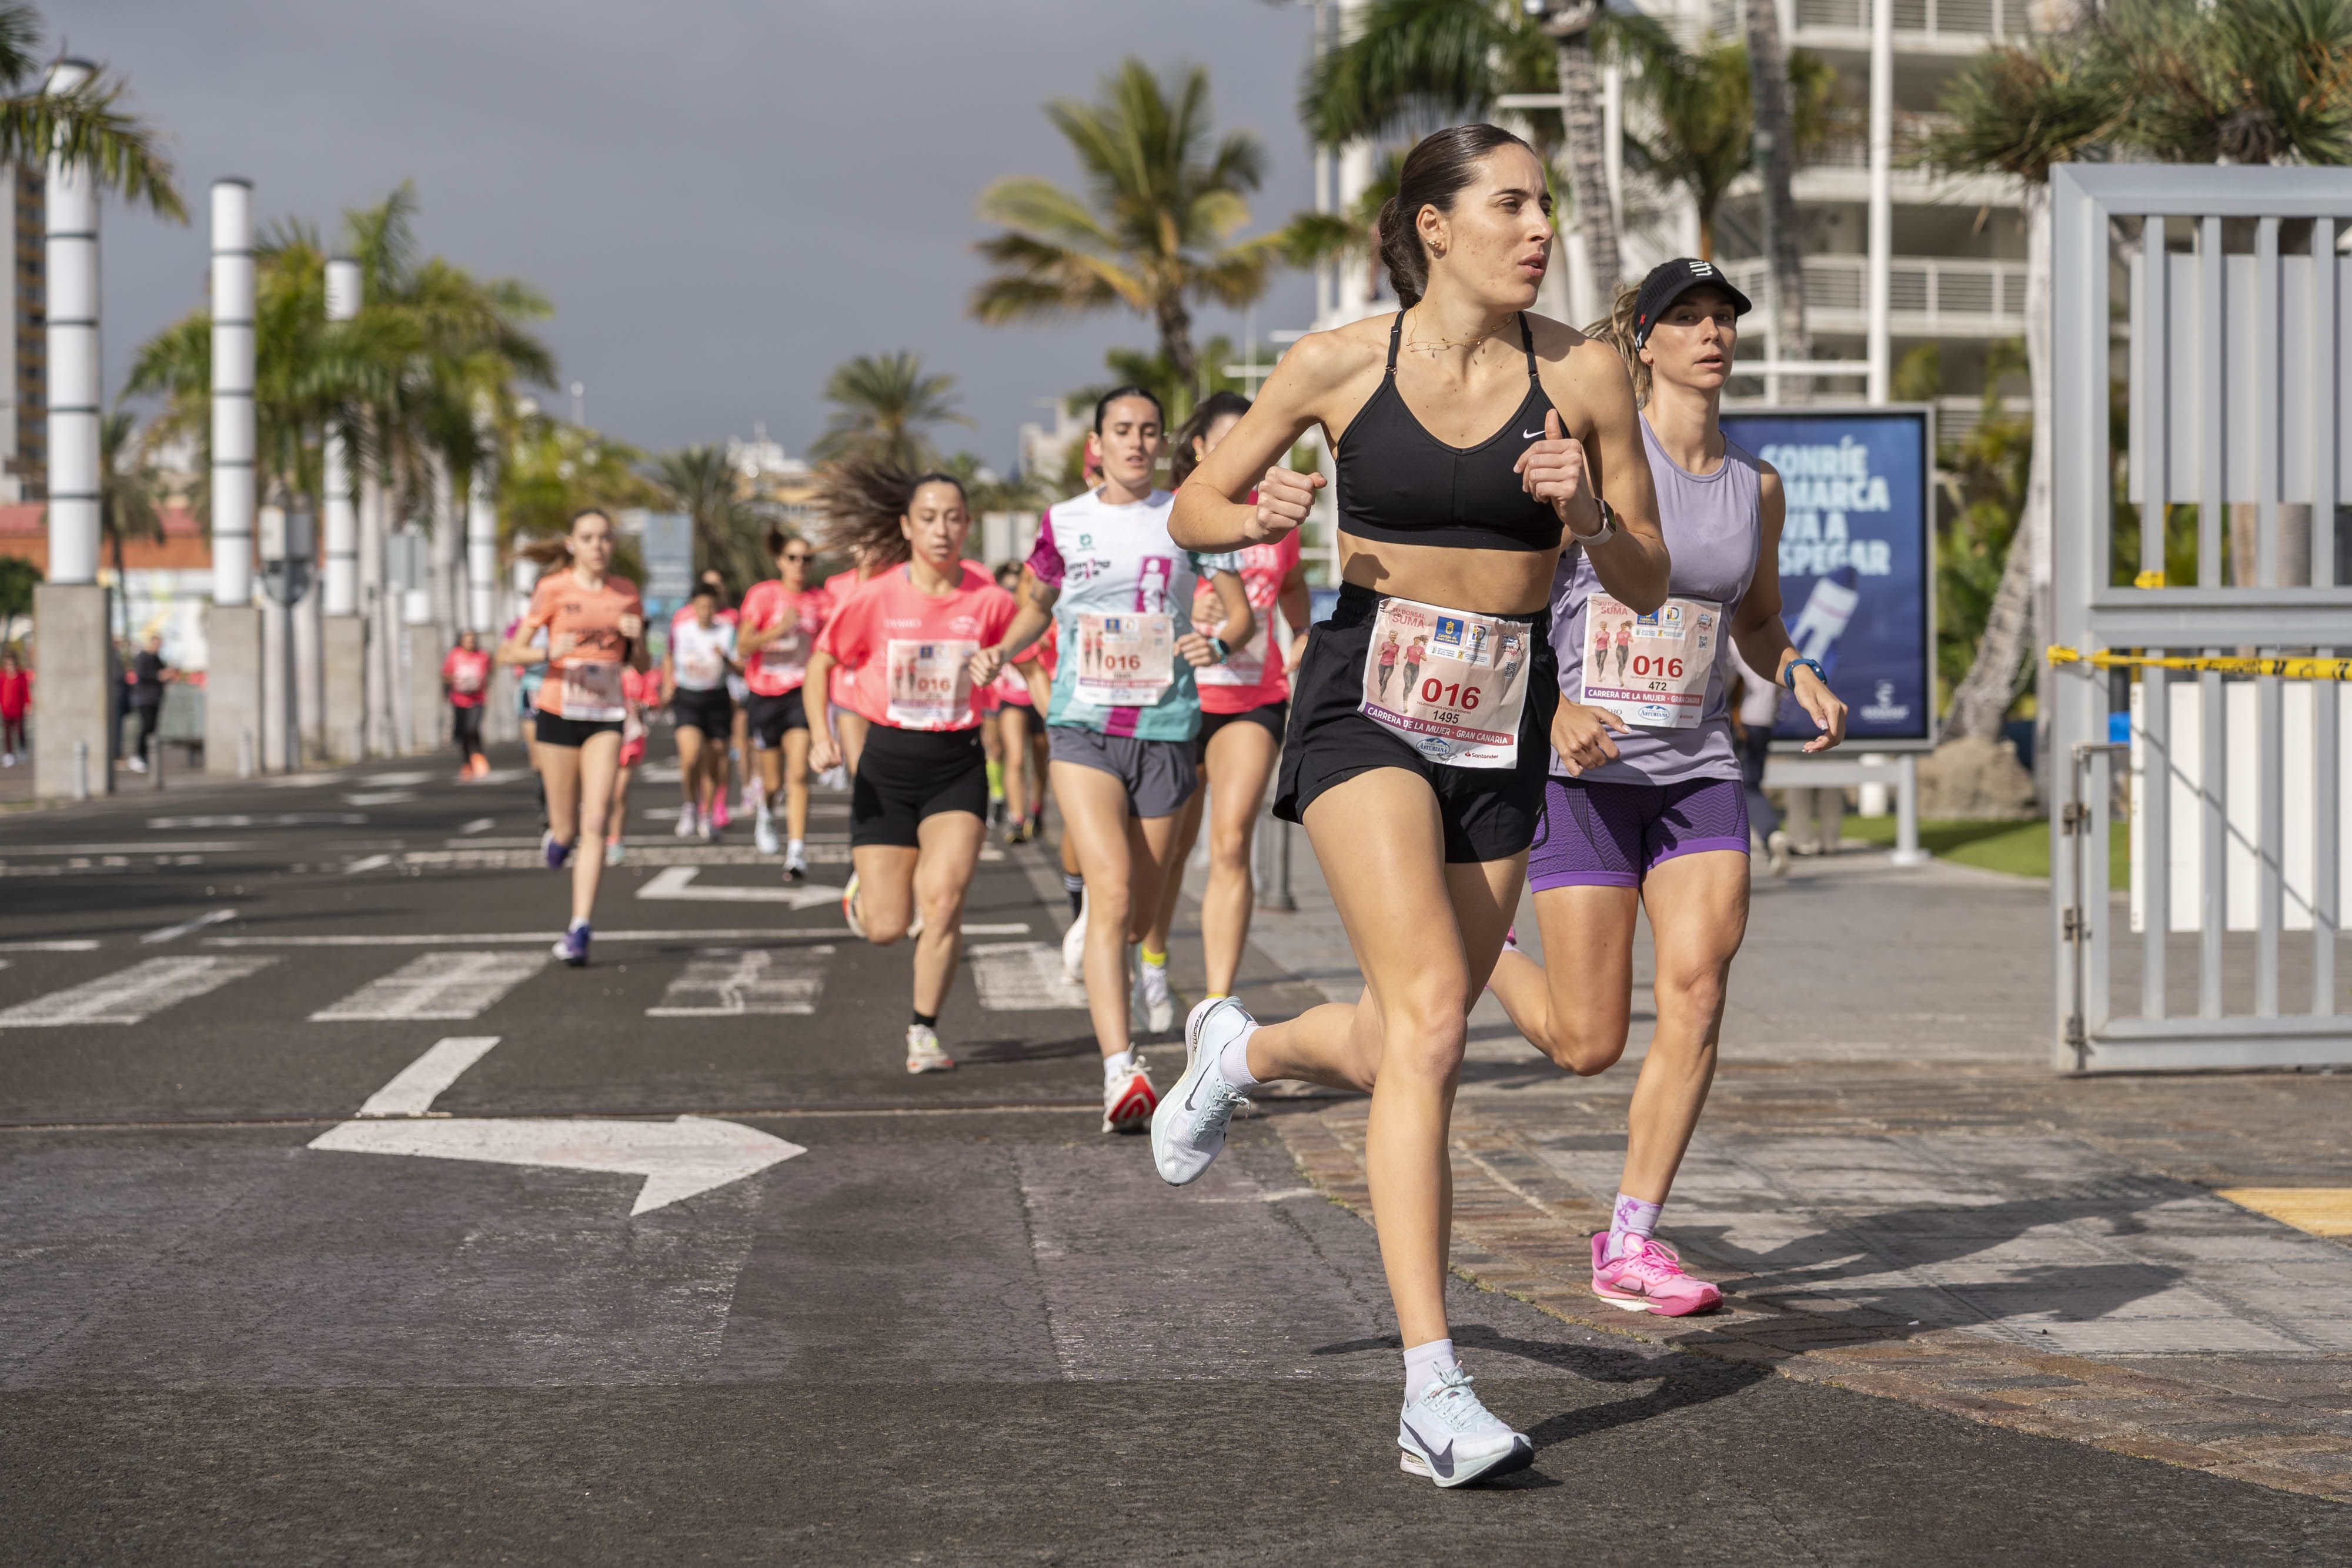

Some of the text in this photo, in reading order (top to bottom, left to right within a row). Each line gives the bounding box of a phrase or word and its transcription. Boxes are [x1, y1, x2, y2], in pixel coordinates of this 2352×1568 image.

[1778, 539, 1891, 577] SPEGAR
[1402, 609, 1425, 619] DORSAL
[1601, 607, 1628, 616] SUMA
[1392, 615, 1425, 628] SUMA
[1105, 654, 1141, 670] 016
[1633, 656, 1683, 678] 016
[917, 677, 951, 692] 016
[1648, 681, 1667, 691] 472
[1421, 678, 1481, 710] 016
[1588, 690, 1619, 698] CARRERA
[1643, 694, 1665, 702] MUJER
[1434, 710, 1460, 724] 1495
[1368, 707, 1508, 744] CARRERA DE LA MUJER GRAN CANARIA
[1193, 1012, 1203, 1052] ZOOMX
